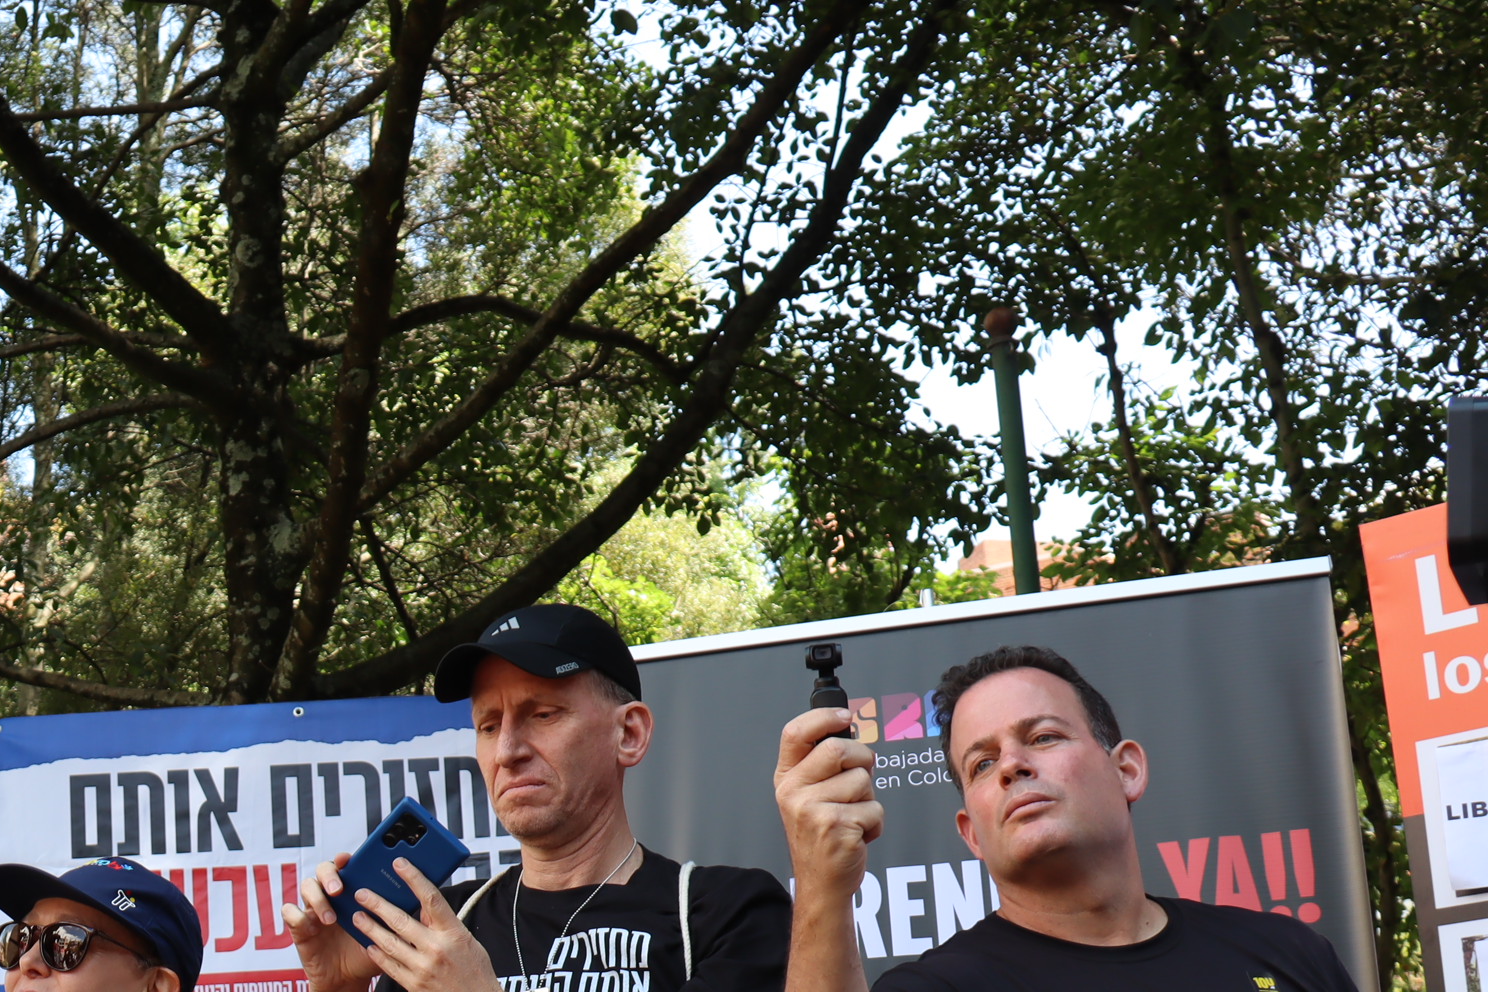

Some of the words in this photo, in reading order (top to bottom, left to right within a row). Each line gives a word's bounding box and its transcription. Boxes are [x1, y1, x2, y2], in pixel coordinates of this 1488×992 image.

[875, 773, 900, 789] en
[69, 766, 244, 860] אותם
[548, 928, 651, 970] מחזירים
